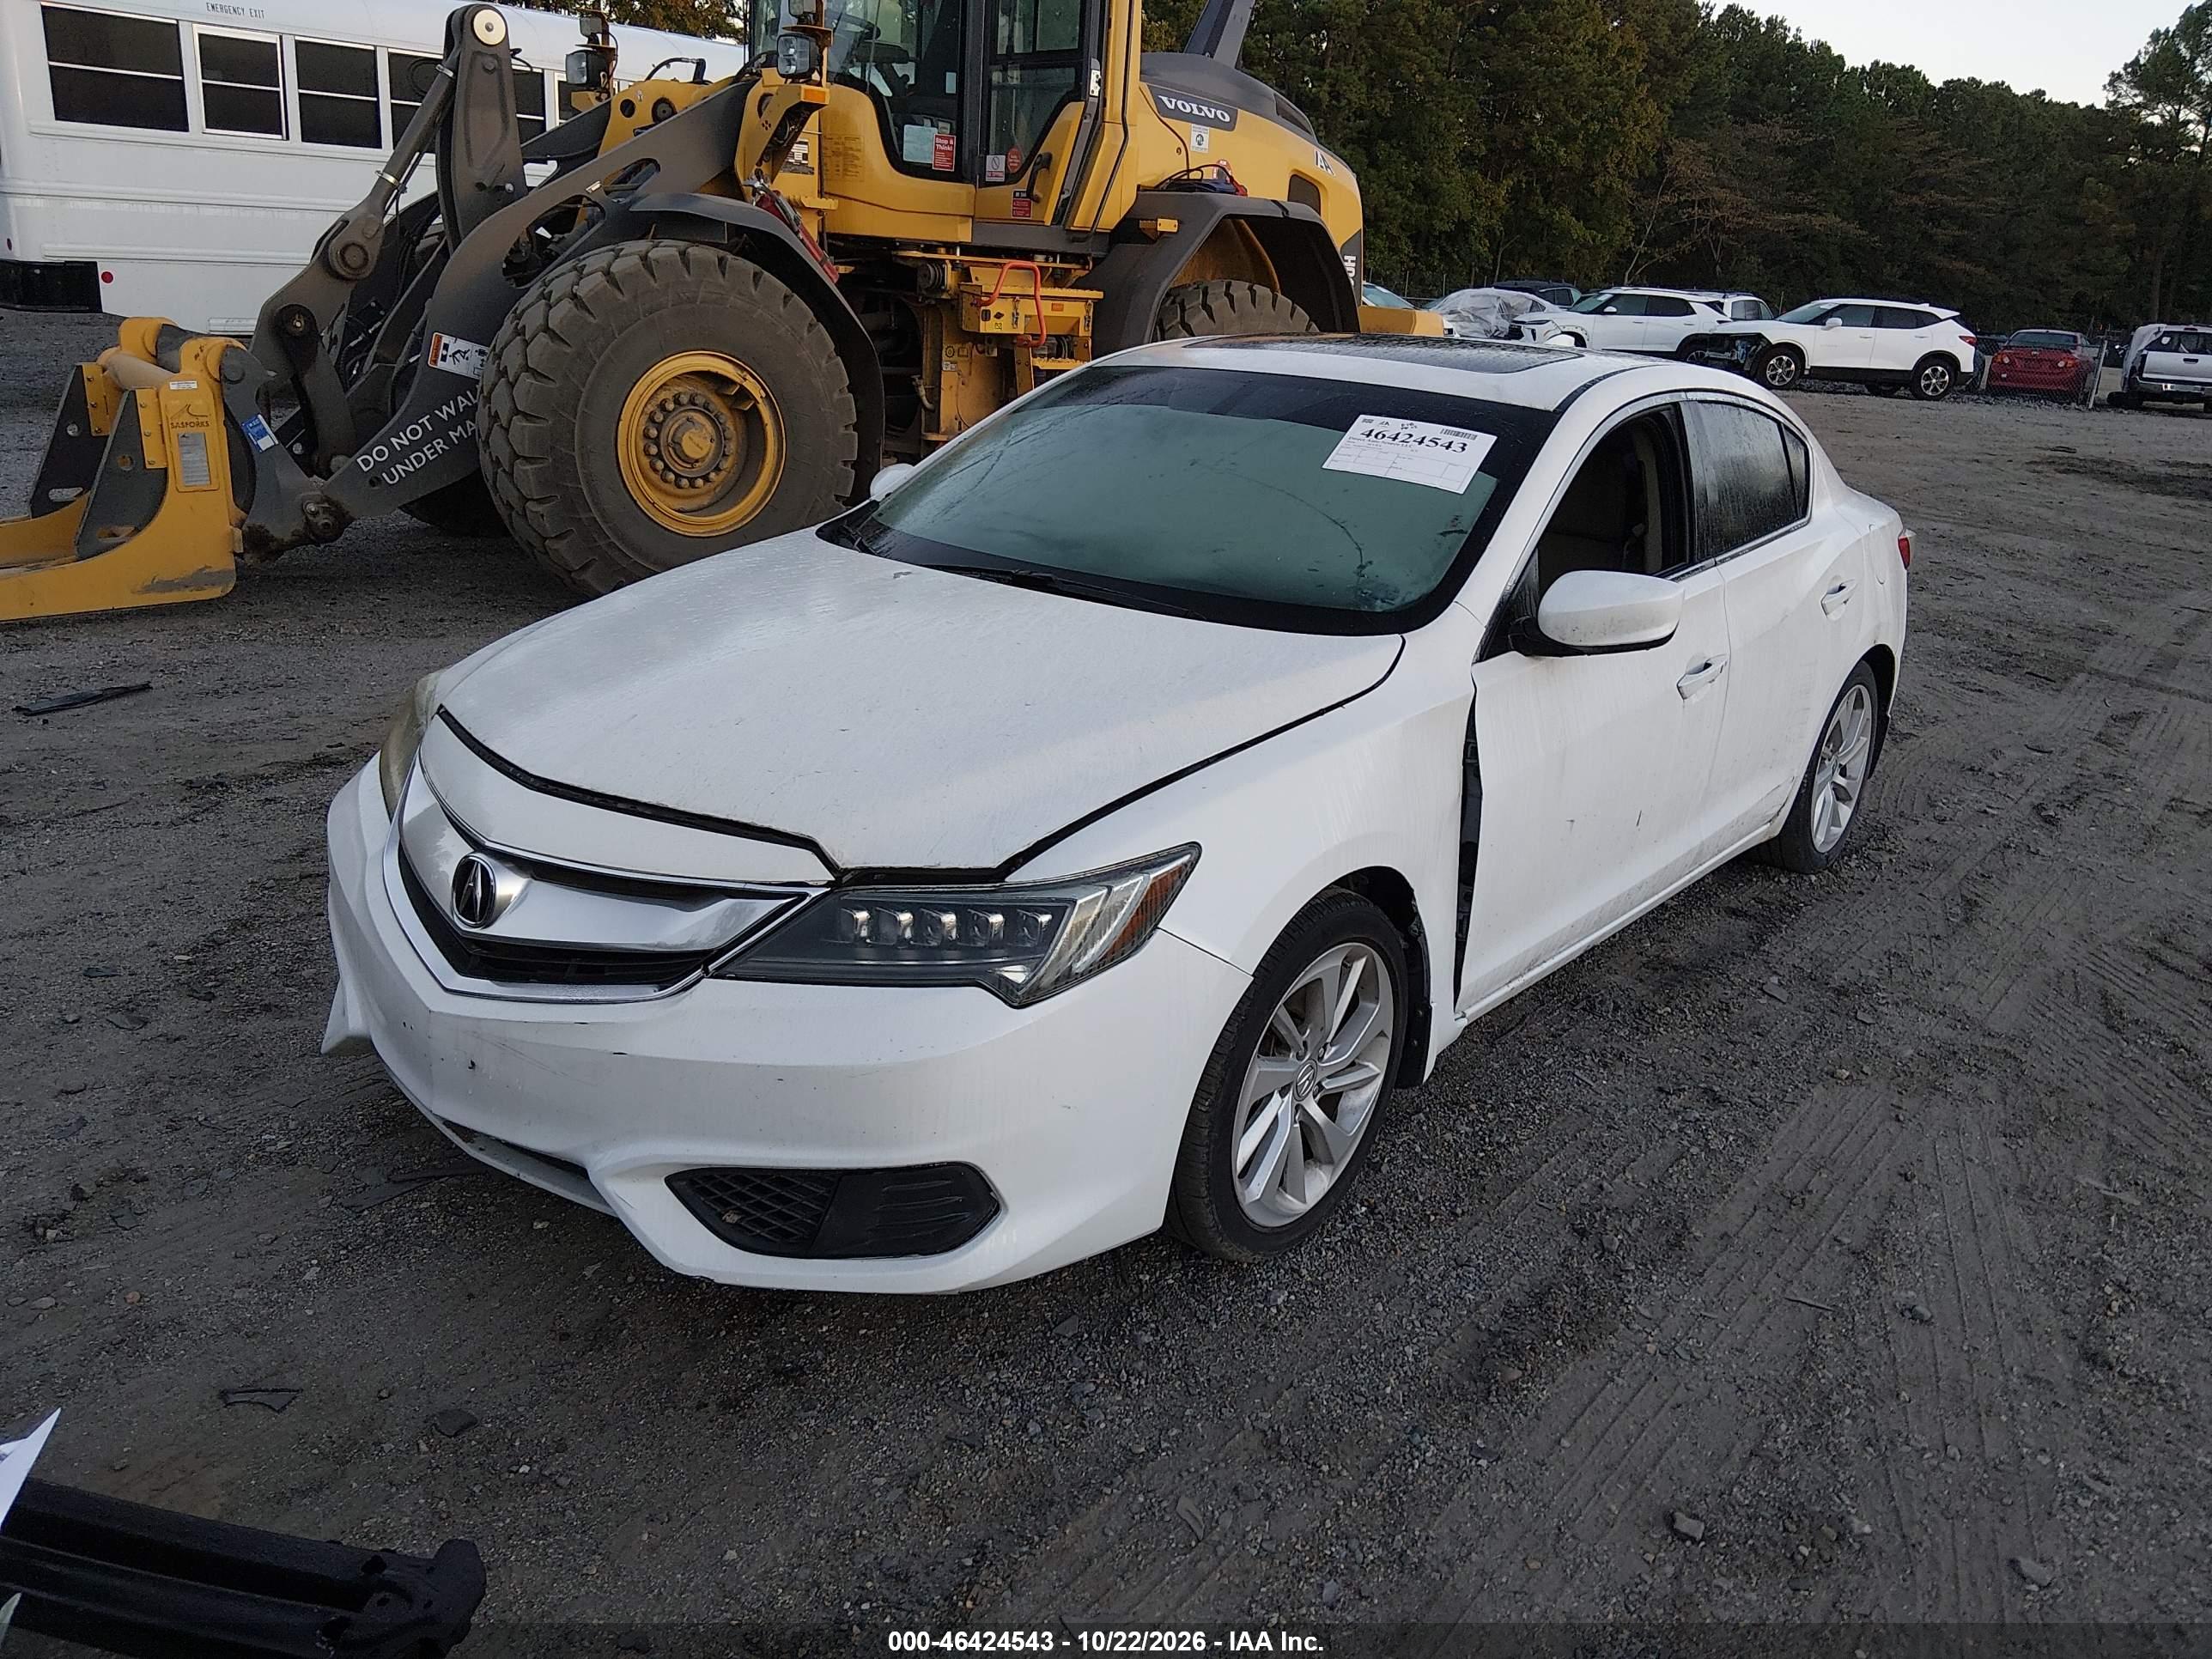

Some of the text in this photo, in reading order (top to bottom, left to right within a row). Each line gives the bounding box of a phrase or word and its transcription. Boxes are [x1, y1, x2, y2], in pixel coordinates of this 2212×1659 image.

[206, 3, 264, 19] EMERGENCY EXIT
[1158, 94, 1231, 122] VOLVO
[356, 385, 479, 472] DO NOT WAL
[1360, 428, 1468, 453] 46424543
[381, 419, 477, 484] UNDER MA
